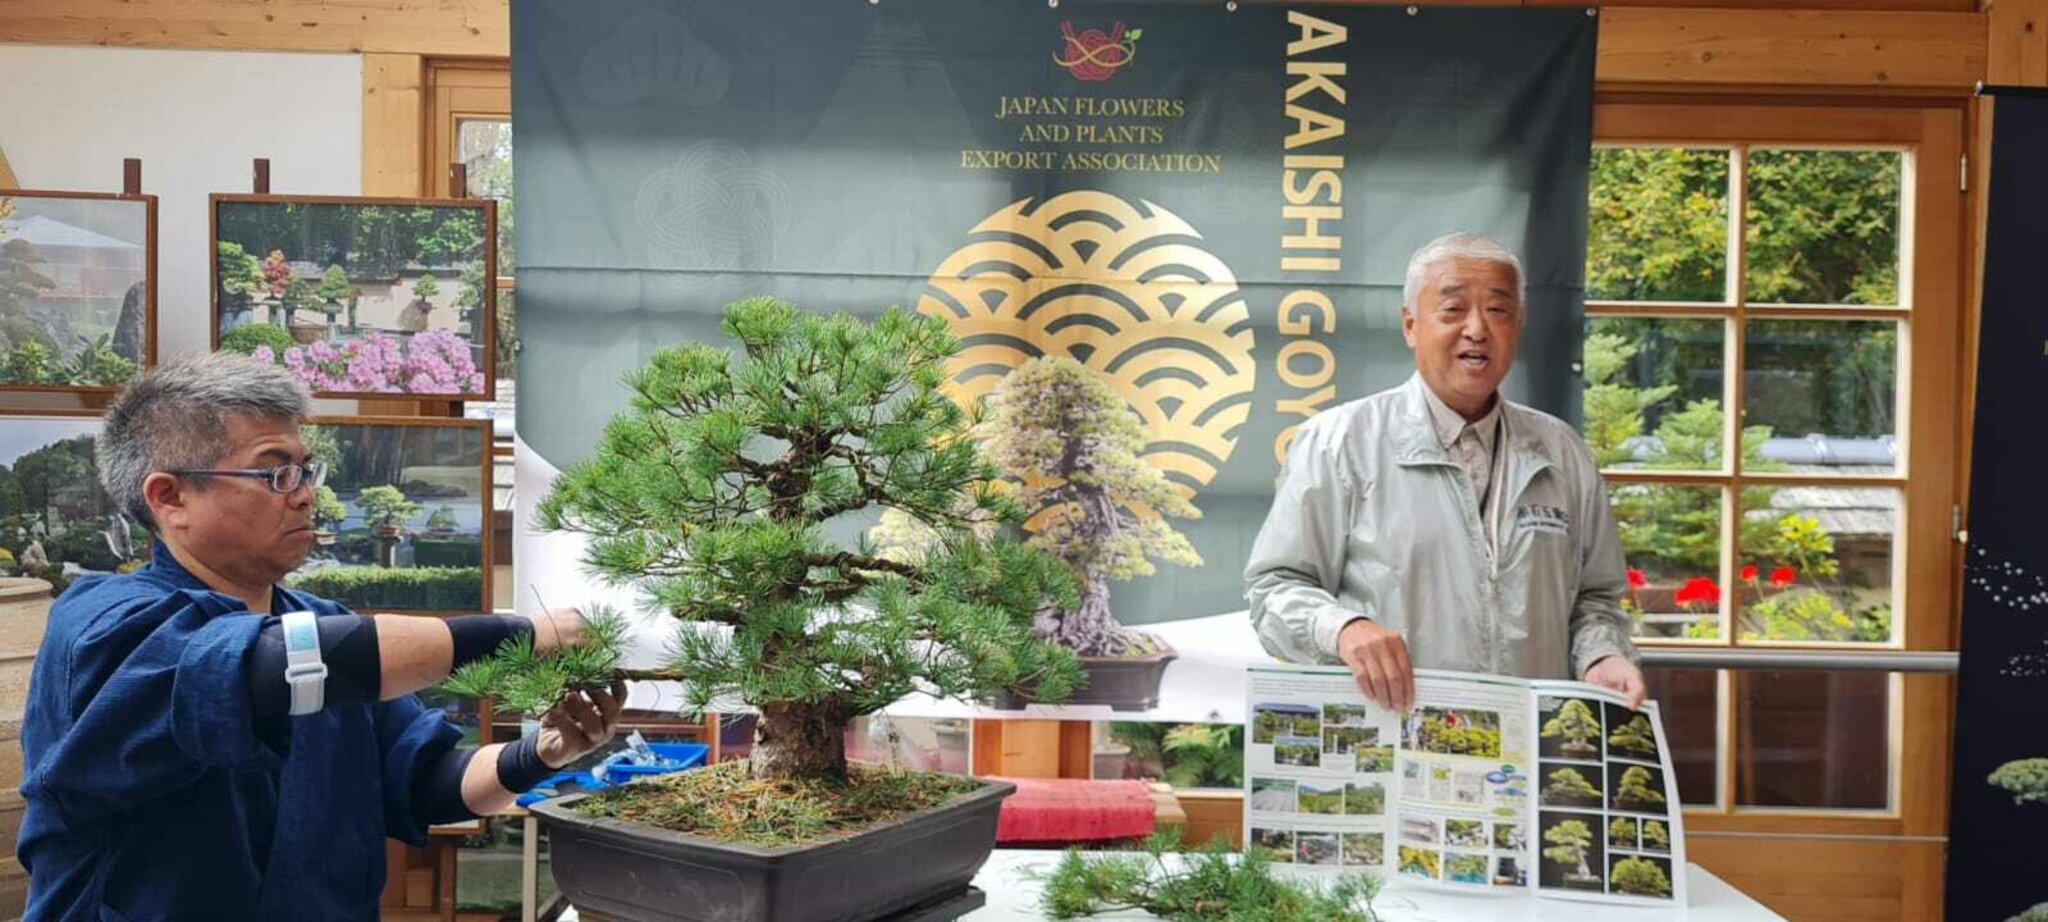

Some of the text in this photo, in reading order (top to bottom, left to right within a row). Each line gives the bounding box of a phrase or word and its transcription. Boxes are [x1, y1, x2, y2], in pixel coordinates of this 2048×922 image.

[995, 96, 1185, 118] JAPAN FLOWERS
[1019, 125, 1163, 144] AND PLANTS
[1281, 10, 1347, 271] AKAISHI
[961, 151, 1221, 173] EXPORT ASSOCIATION
